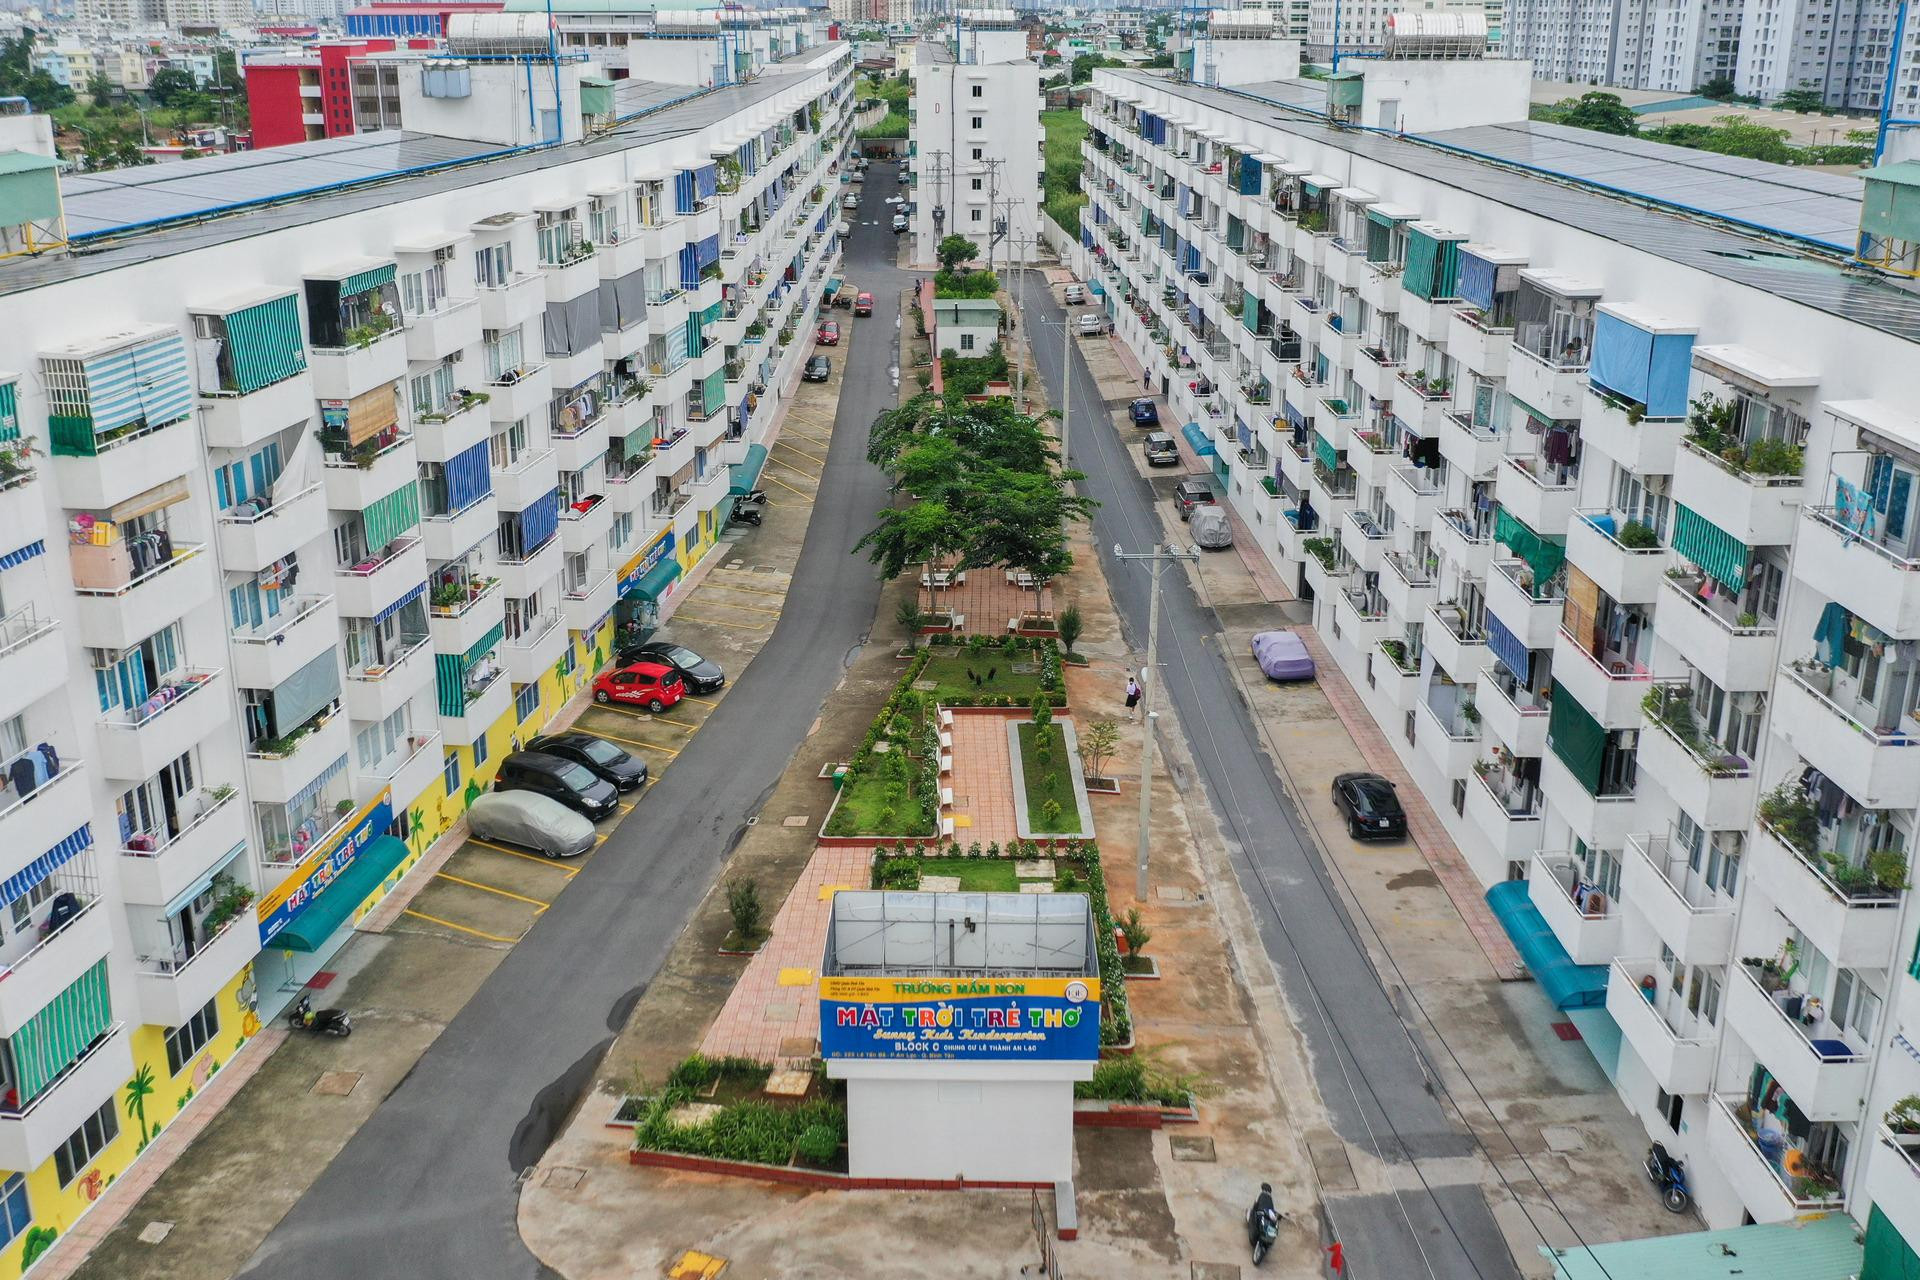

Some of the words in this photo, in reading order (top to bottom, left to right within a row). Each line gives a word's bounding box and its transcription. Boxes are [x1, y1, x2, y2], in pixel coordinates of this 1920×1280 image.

[994, 982, 1025, 995] NON
[836, 1003, 894, 1031] MẶT
[901, 1002, 964, 1028] TRỜI
[971, 1000, 1021, 1028] TRẺ
[1028, 1006, 1083, 1028] THƠ
[873, 1028, 916, 1042] Sunny
[919, 1028, 954, 1040] Kids
[957, 1028, 1047, 1042] Kindergarten
[895, 1042, 929, 1051] BLOCK
[979, 1043, 987, 1051] LÊ
